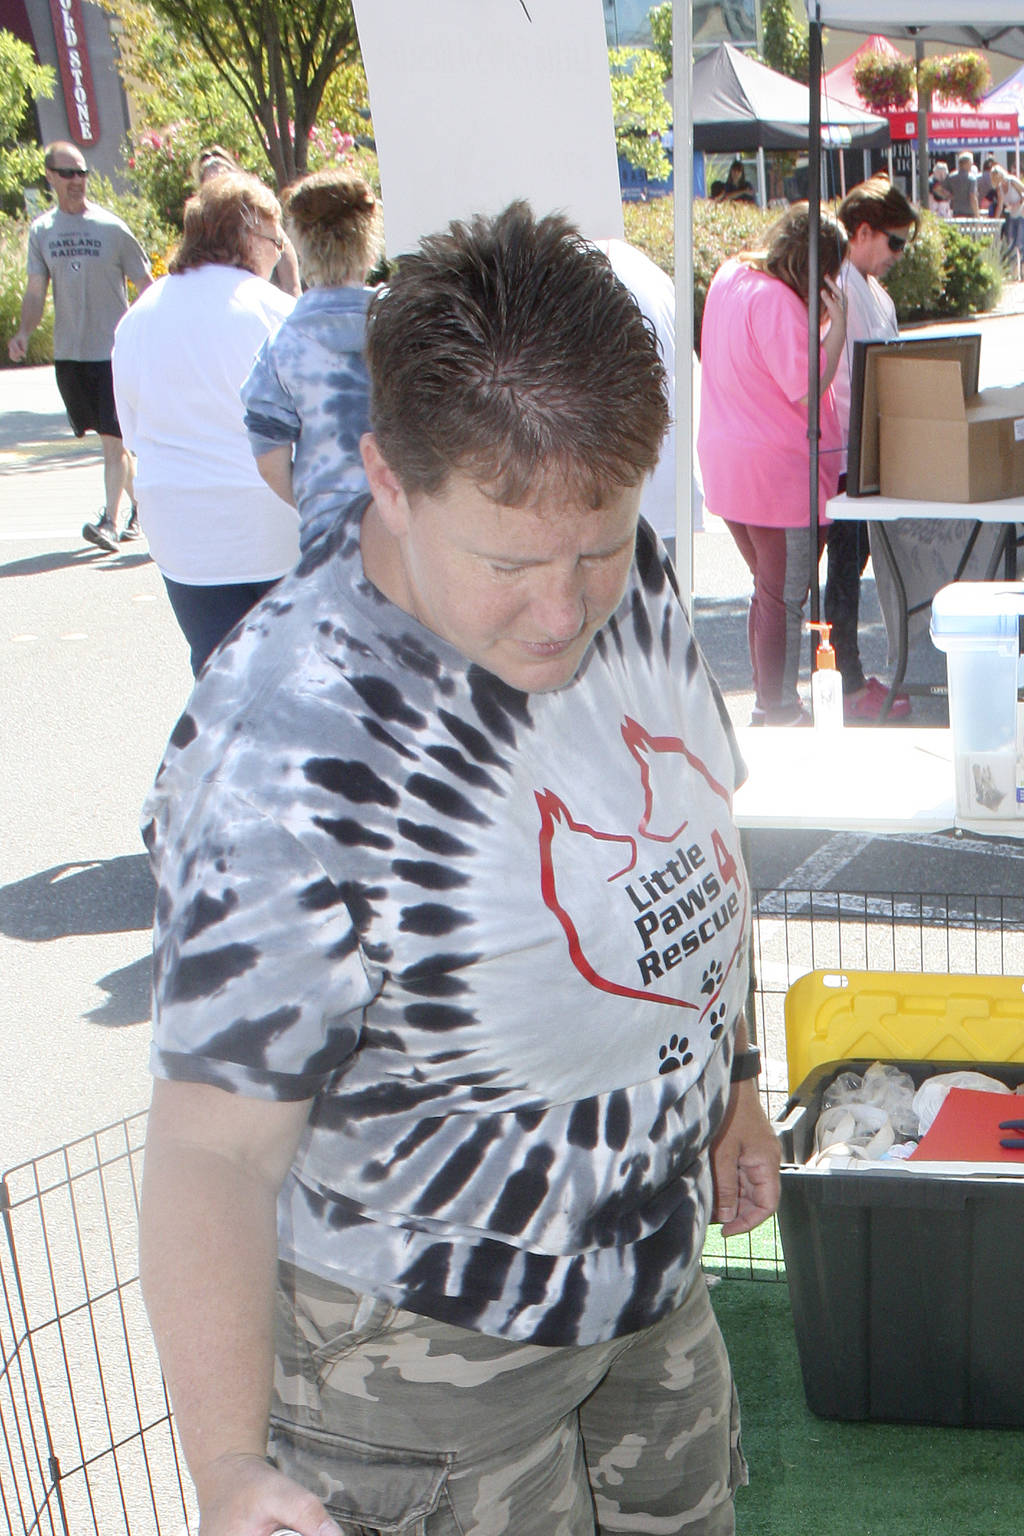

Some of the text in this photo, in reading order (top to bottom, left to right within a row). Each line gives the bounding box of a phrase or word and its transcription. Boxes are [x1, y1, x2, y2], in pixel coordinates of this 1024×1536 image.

[67, 48, 93, 140] STONE
[49, 239, 102, 249] OAKLAND
[51, 248, 99, 257] RAIDERS
[624, 843, 706, 913] Little
[633, 829, 742, 951] Paws 4
[636, 892, 740, 987] Rescue
